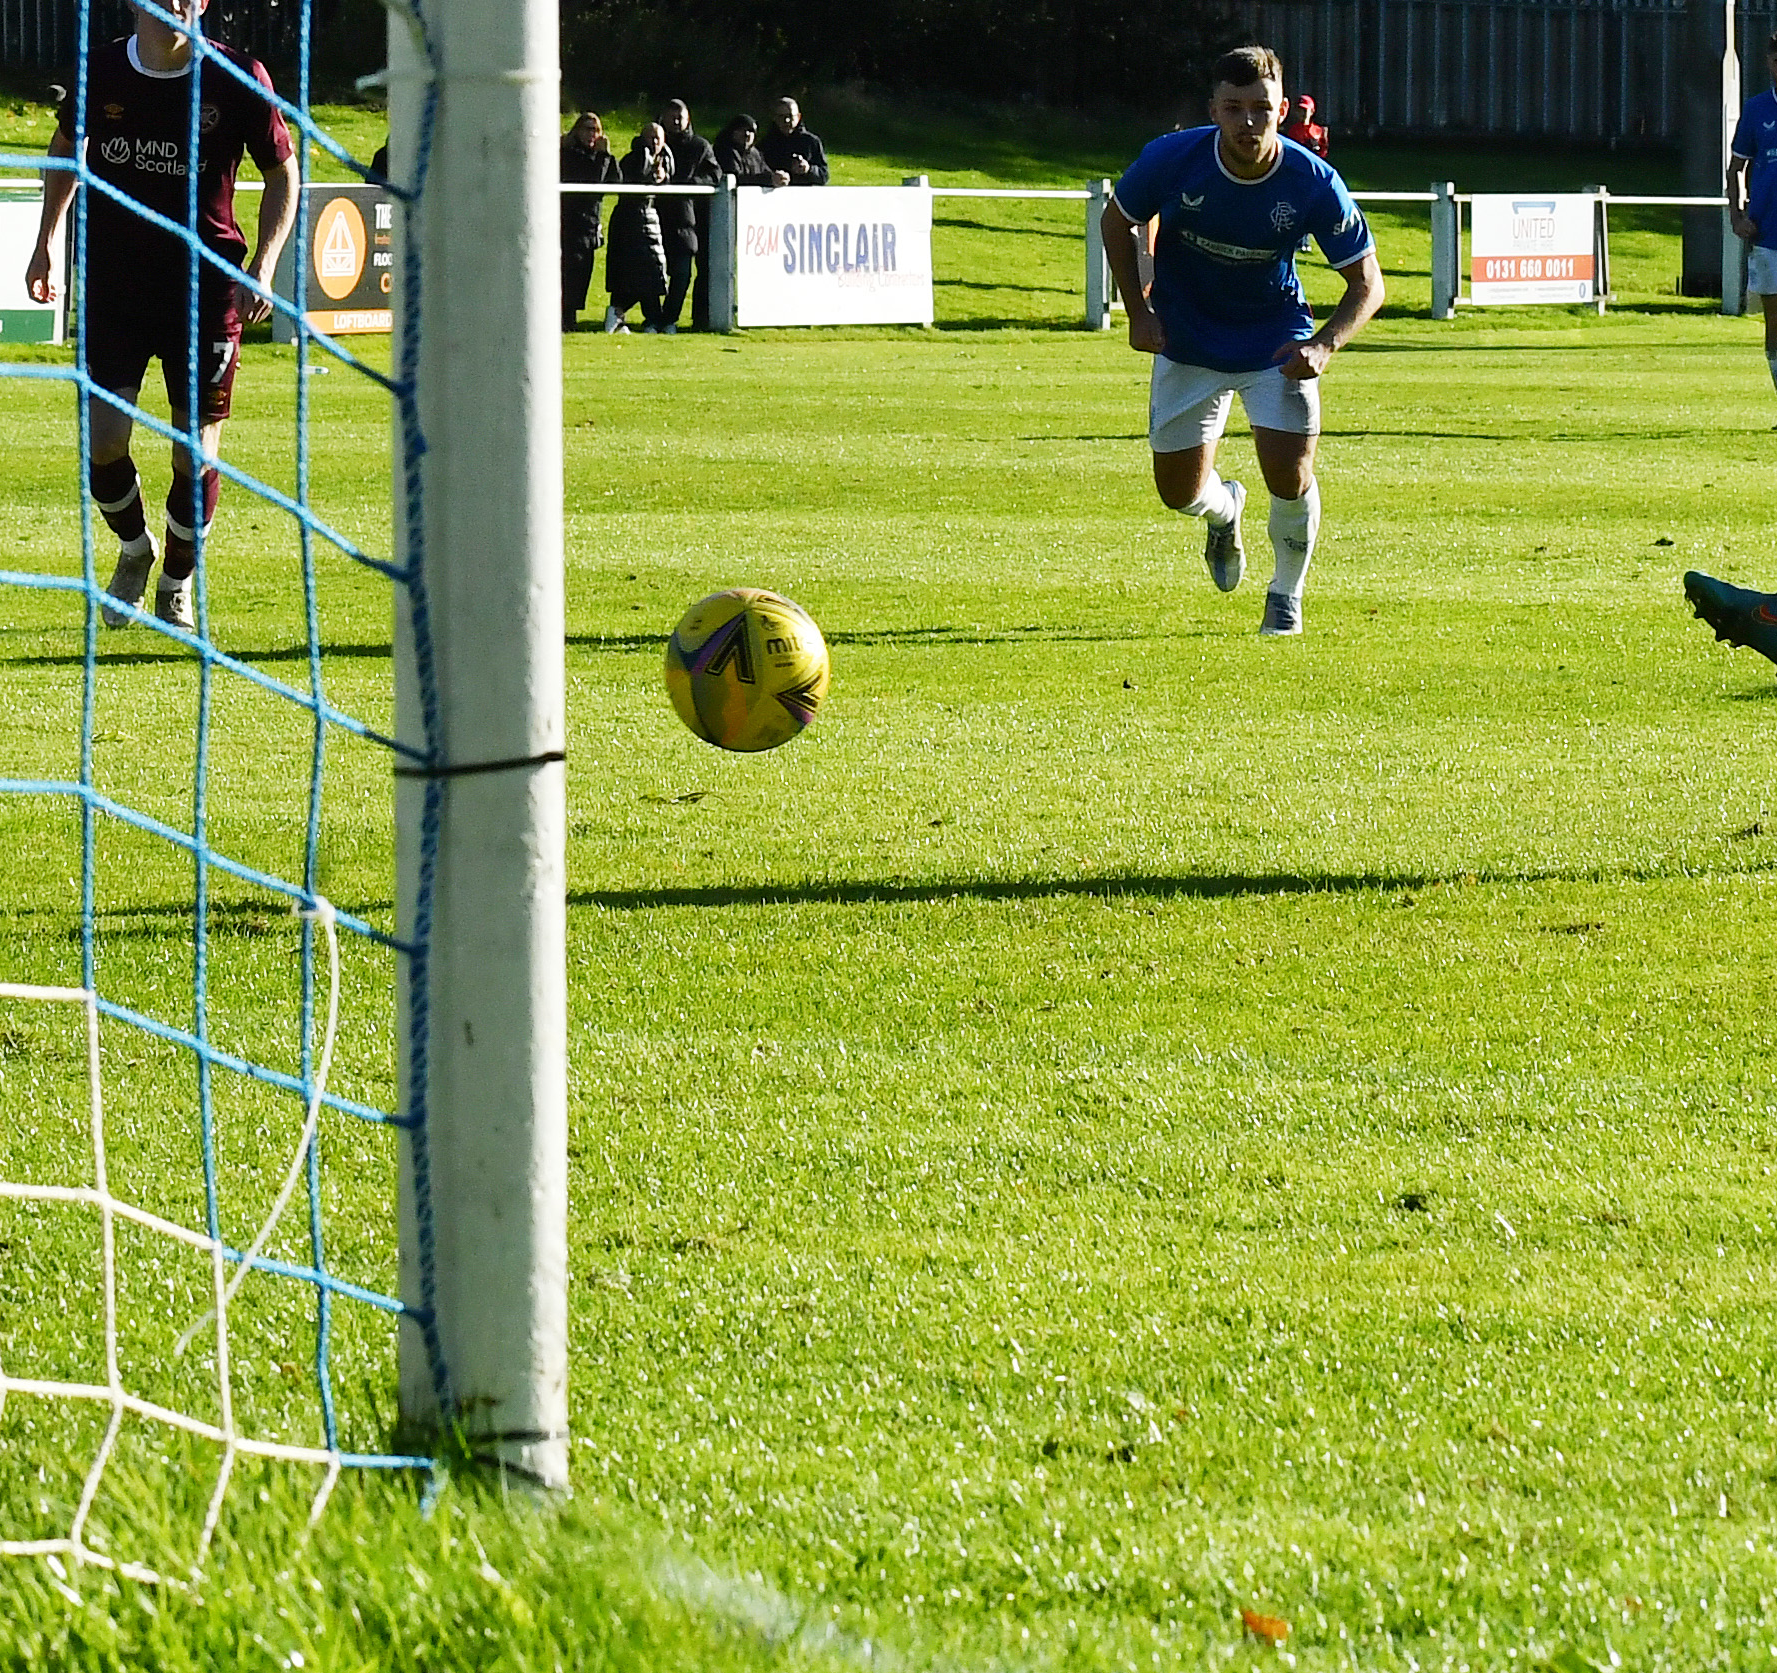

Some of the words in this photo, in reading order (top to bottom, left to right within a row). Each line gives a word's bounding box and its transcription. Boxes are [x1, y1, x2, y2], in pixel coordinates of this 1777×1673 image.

[135, 137, 178, 158] MND
[134, 154, 208, 176] Scotlad
[1511, 217, 1556, 239] UNITED
[745, 224, 780, 257] P&M
[782, 223, 897, 274] SINCLAIR
[1485, 258, 1516, 279] 0131
[1519, 258, 1543, 278] 660
[1545, 257, 1574, 277] 0011
[209, 341, 235, 384] 7
